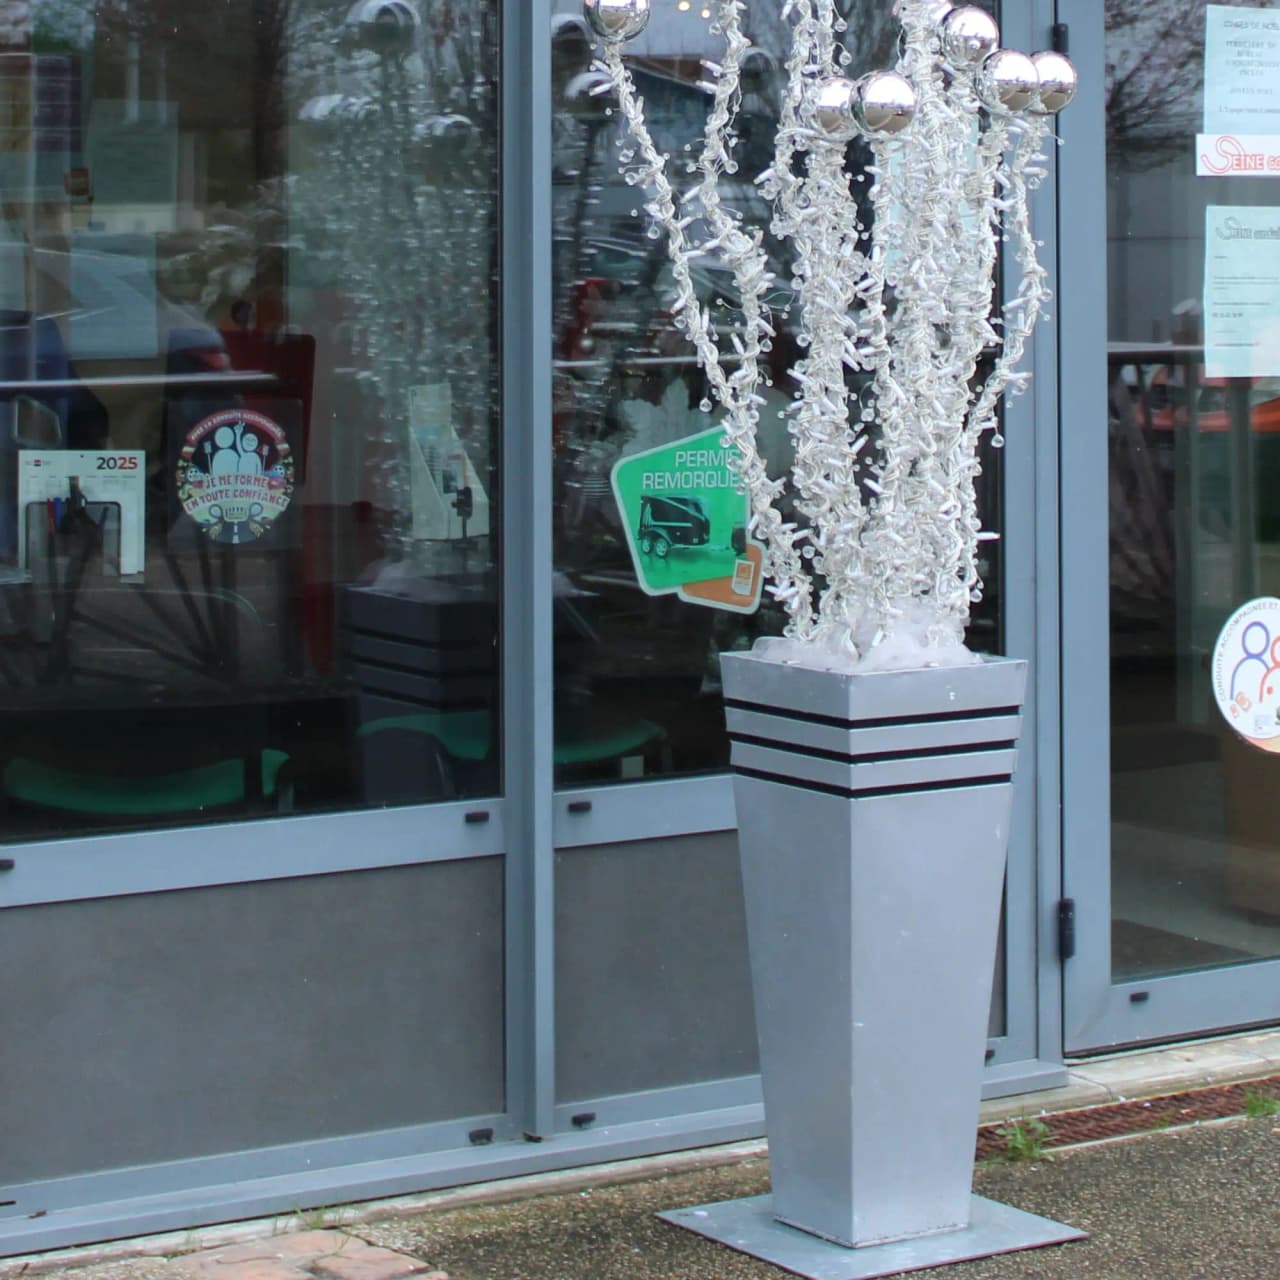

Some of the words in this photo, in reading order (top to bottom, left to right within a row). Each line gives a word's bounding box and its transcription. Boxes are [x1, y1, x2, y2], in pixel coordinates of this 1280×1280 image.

[1201, 135, 1264, 174] SEINE
[96, 456, 138, 470] 2025
[220, 475, 233, 486] ME
[235, 474, 267, 488] FORME
[642, 470, 740, 489] REMORQUE
[185, 498, 199, 513] EN
[200, 488, 230, 504] TOUTE
[233, 488, 287, 508] CONFIANCE
